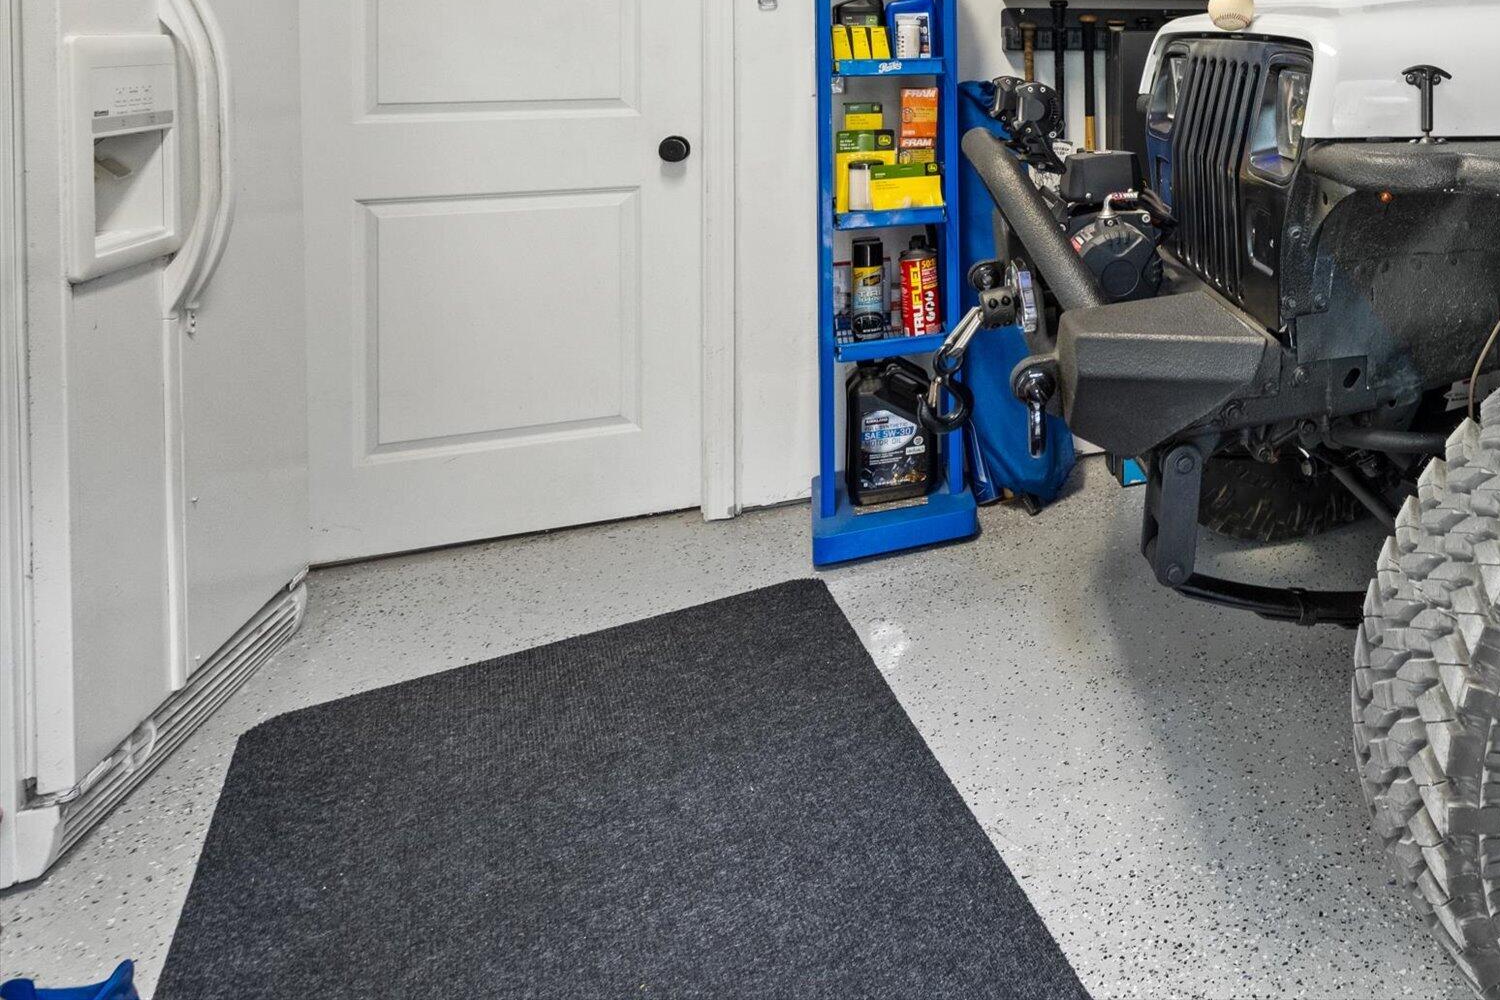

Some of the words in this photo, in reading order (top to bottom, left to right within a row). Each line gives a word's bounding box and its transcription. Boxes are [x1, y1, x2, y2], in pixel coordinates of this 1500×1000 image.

[905, 89, 936, 98] FRAM
[902, 138, 932, 147] FRAM
[909, 264, 926, 337] TRUFUEL
[864, 432, 881, 440] SAE
[882, 428, 911, 438] 5W-30
